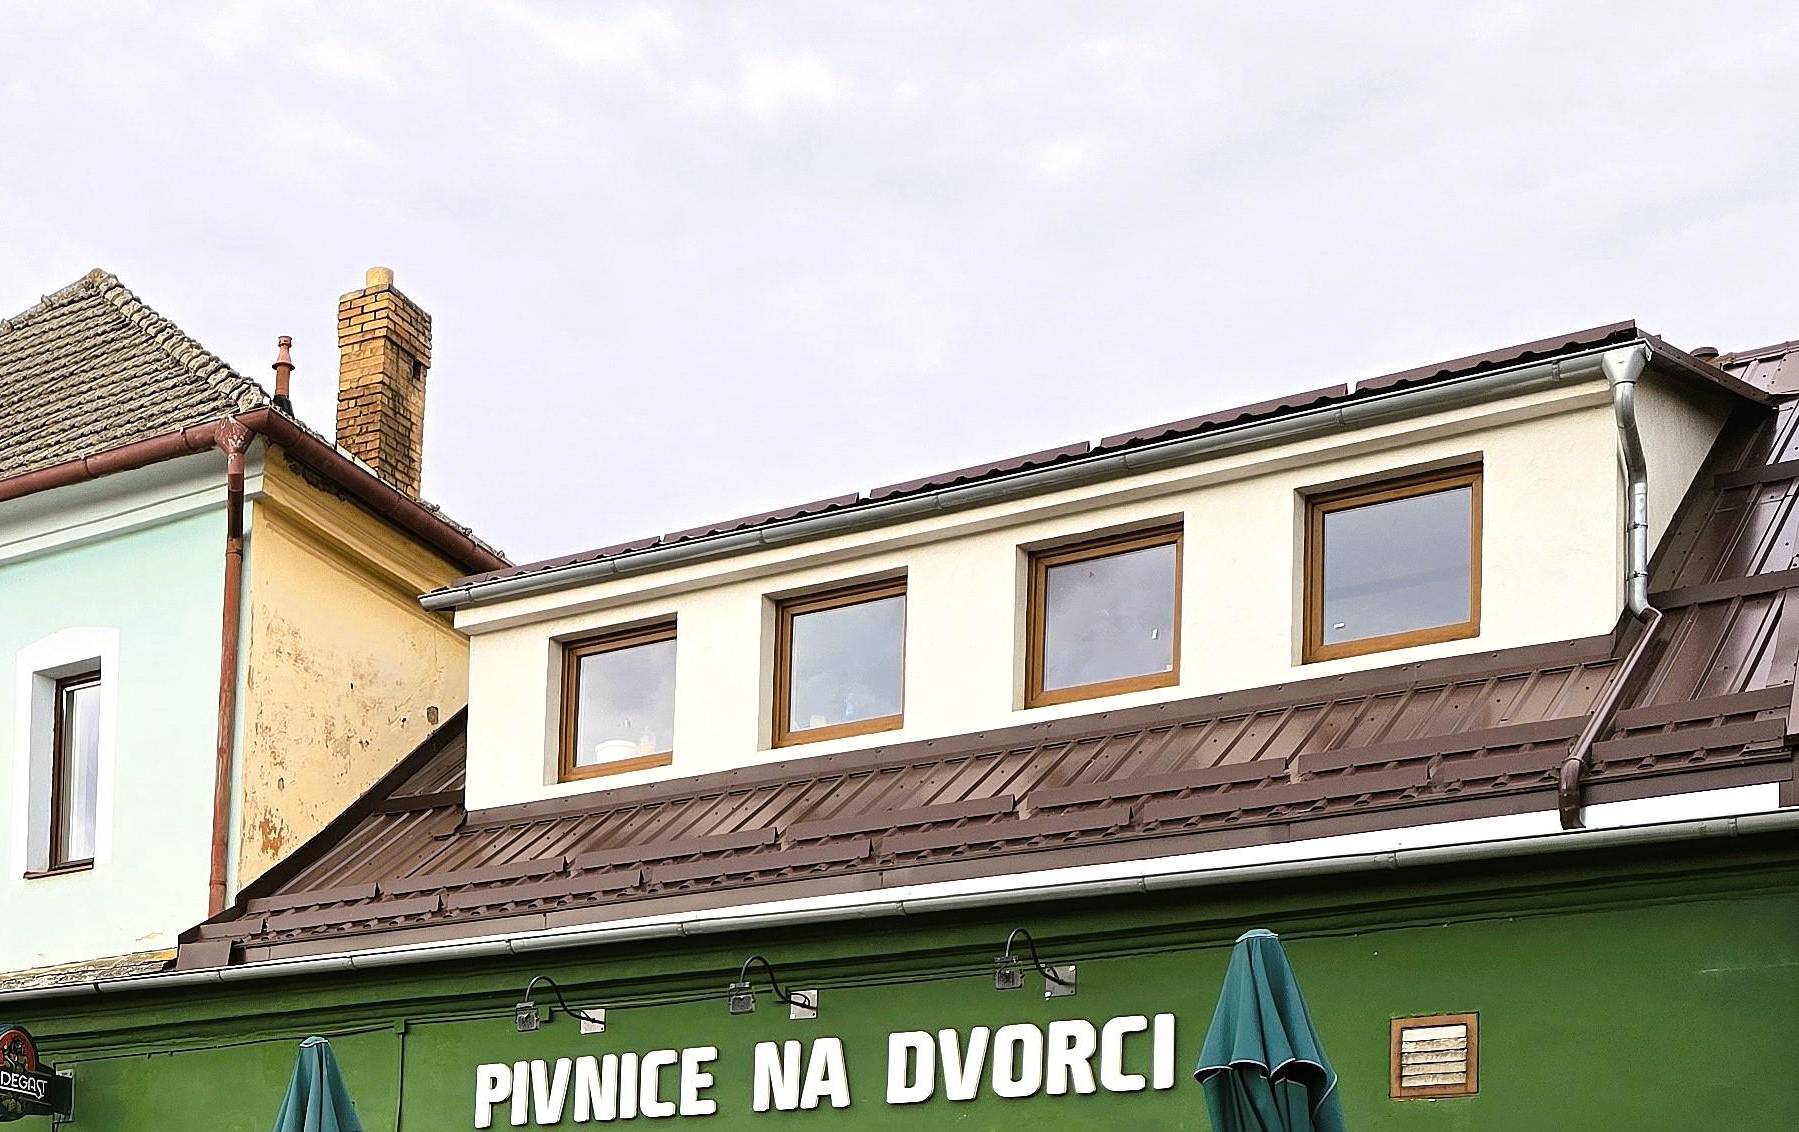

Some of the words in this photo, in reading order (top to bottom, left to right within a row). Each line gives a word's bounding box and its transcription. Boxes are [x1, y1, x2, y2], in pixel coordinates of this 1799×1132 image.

[474, 1046, 717, 1130] PIVNICE
[752, 1036, 851, 1113] NA
[885, 1012, 1176, 1106] DVORCI
